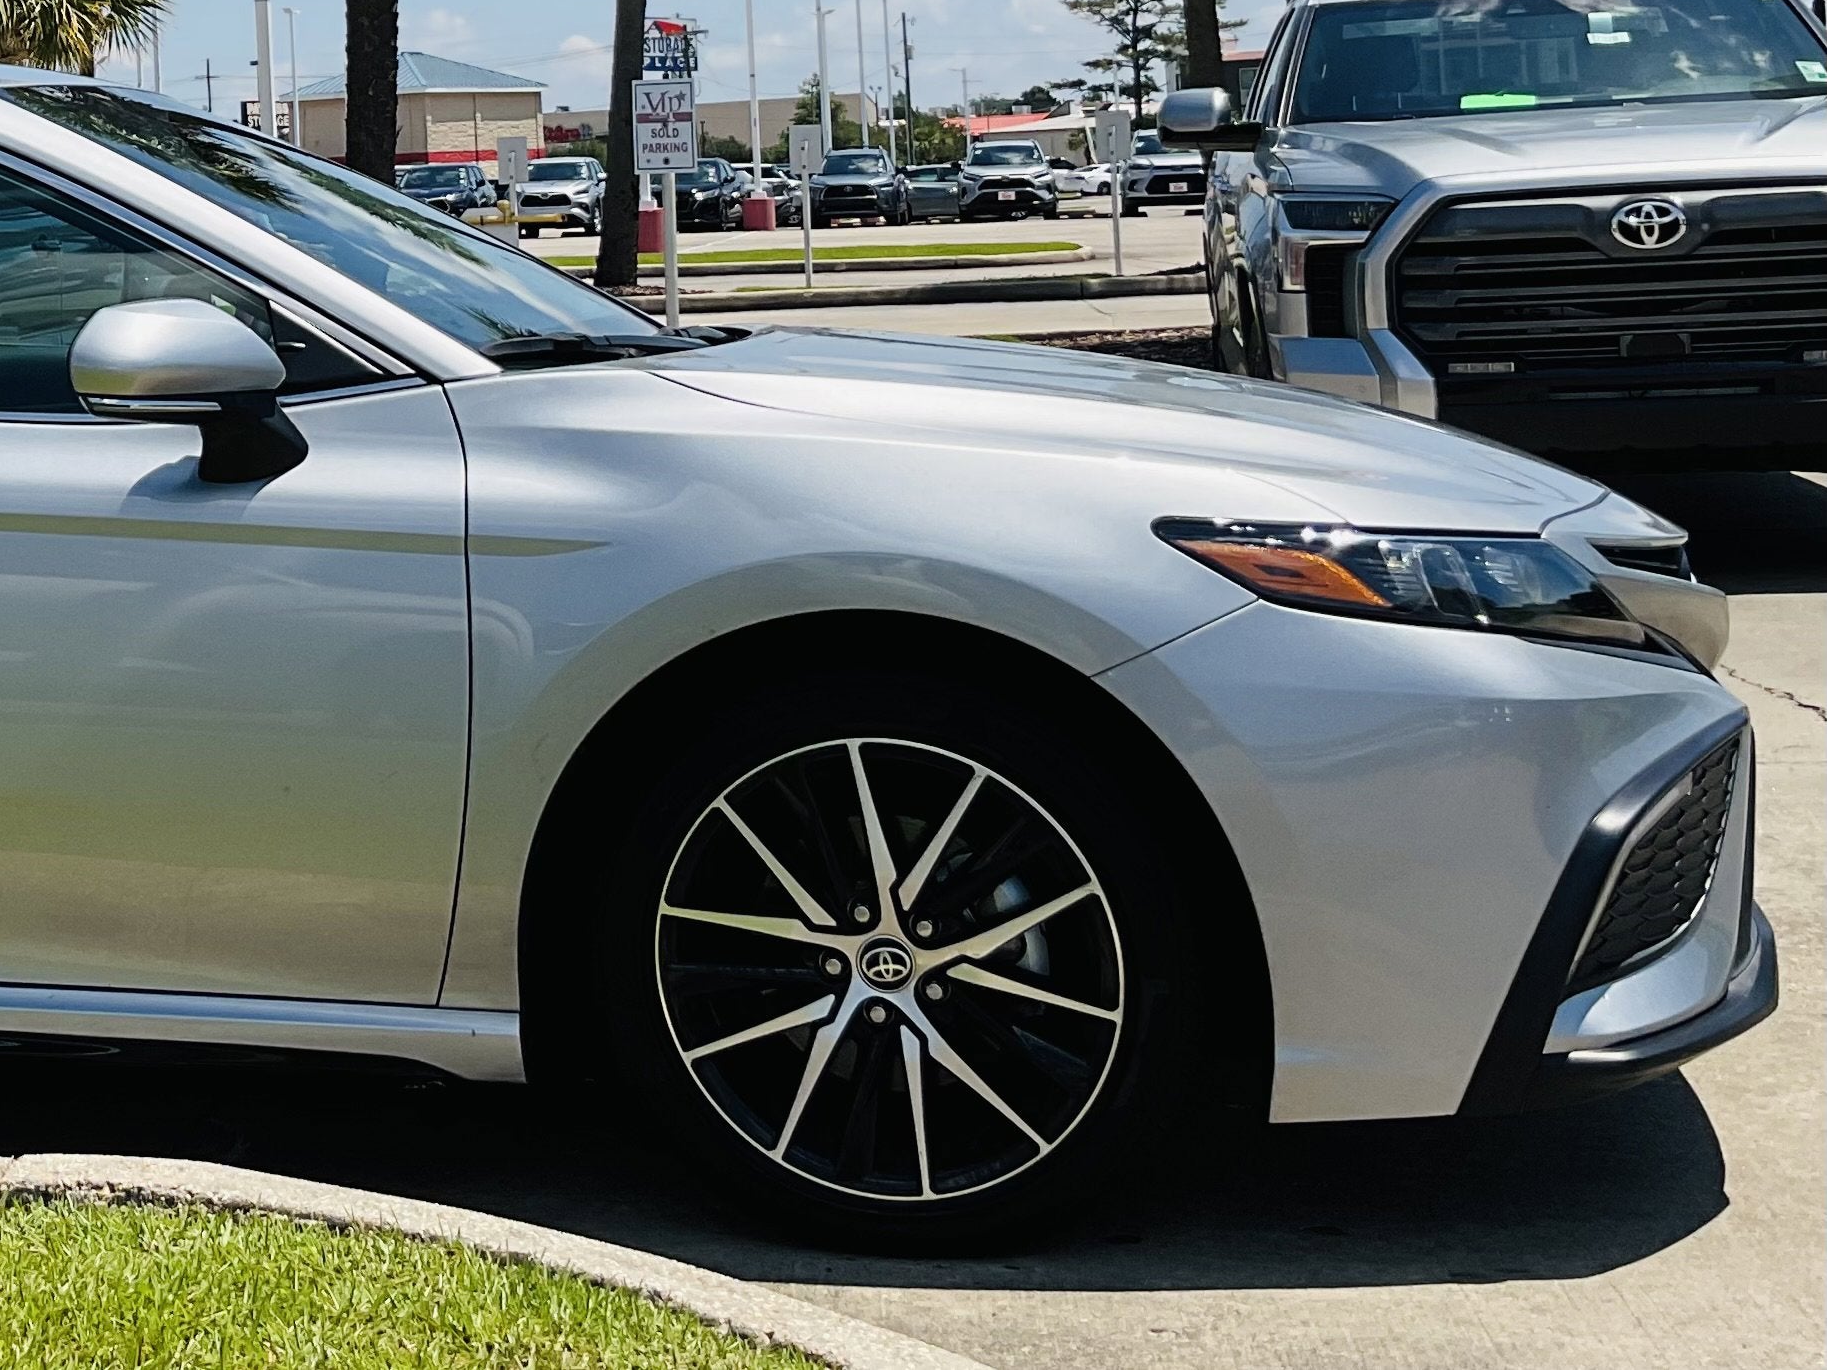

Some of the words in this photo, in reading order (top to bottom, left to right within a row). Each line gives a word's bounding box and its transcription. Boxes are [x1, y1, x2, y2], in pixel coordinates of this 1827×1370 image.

[247, 114, 290, 128] STGE
[650, 127, 679, 139] SOLD
[642, 142, 688, 154] PARKING
